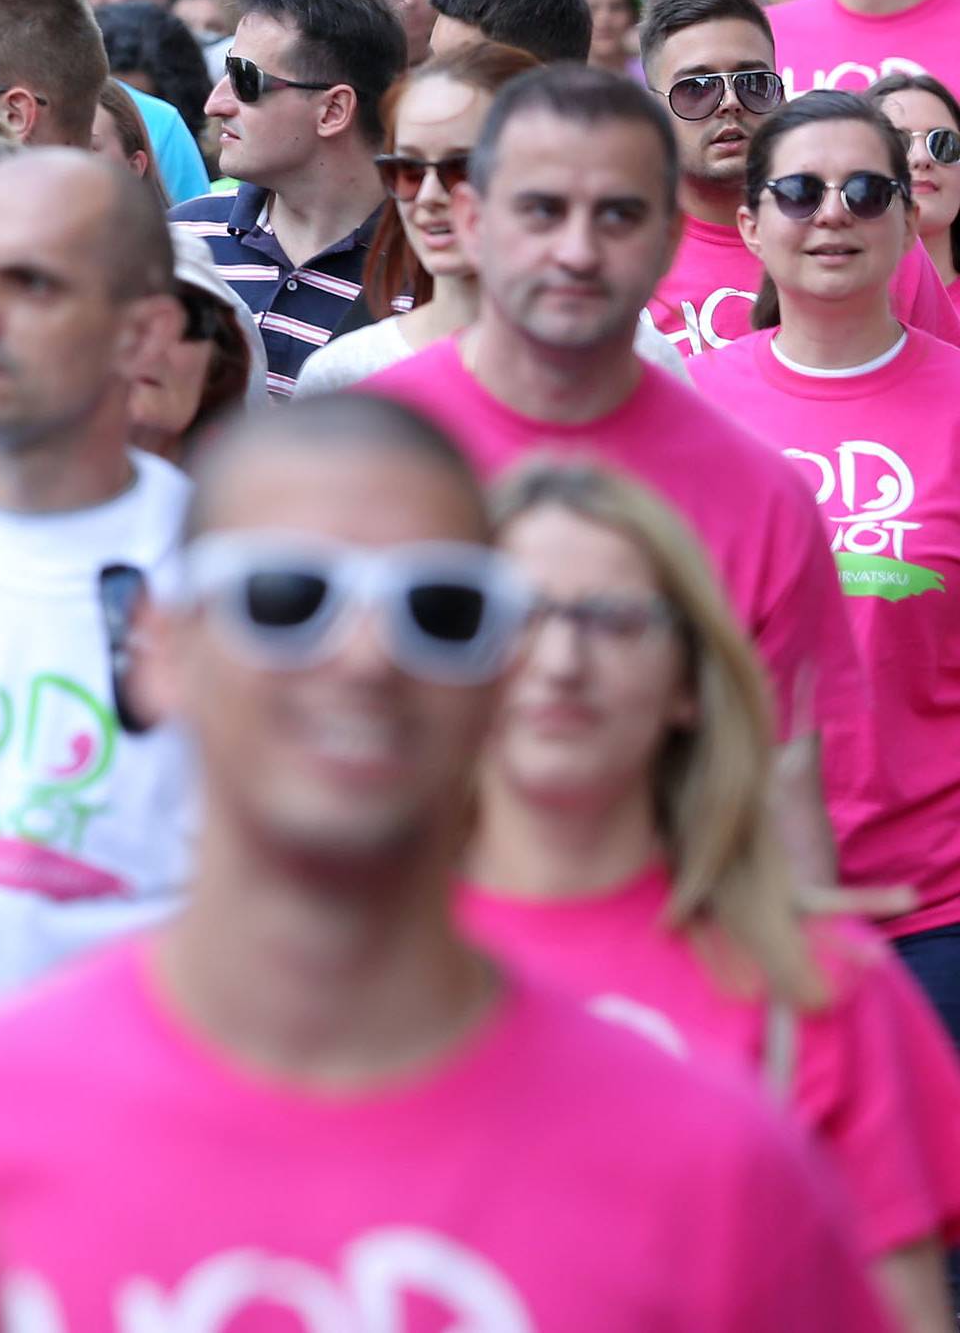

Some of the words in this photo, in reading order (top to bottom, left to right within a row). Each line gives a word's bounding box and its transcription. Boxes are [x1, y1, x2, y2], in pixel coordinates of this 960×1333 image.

[782, 57, 929, 102] HO
[781, 439, 916, 523] OD
[838, 570, 912, 587] RVATSKU
